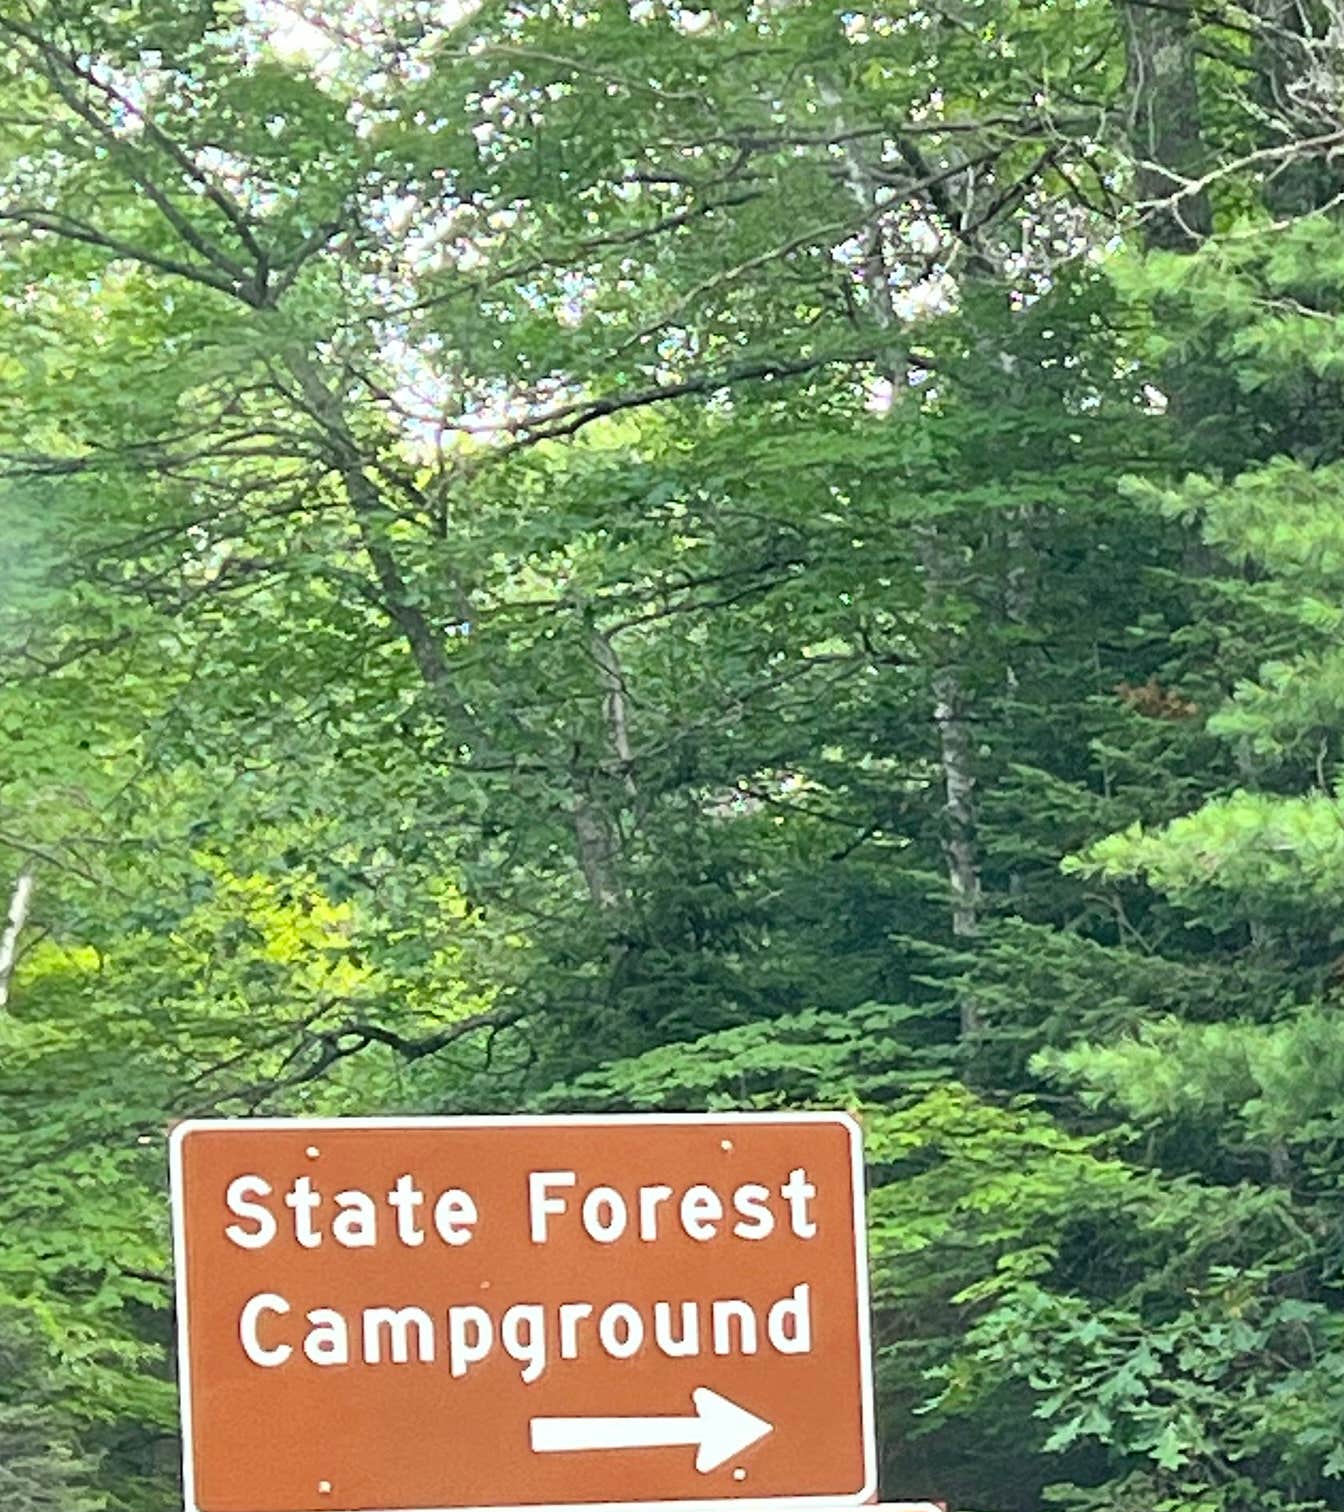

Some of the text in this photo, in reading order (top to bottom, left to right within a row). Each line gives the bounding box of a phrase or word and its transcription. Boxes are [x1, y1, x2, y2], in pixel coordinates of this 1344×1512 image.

[225, 1168, 818, 1250] State Forest
[240, 1283, 812, 1382] Campground
